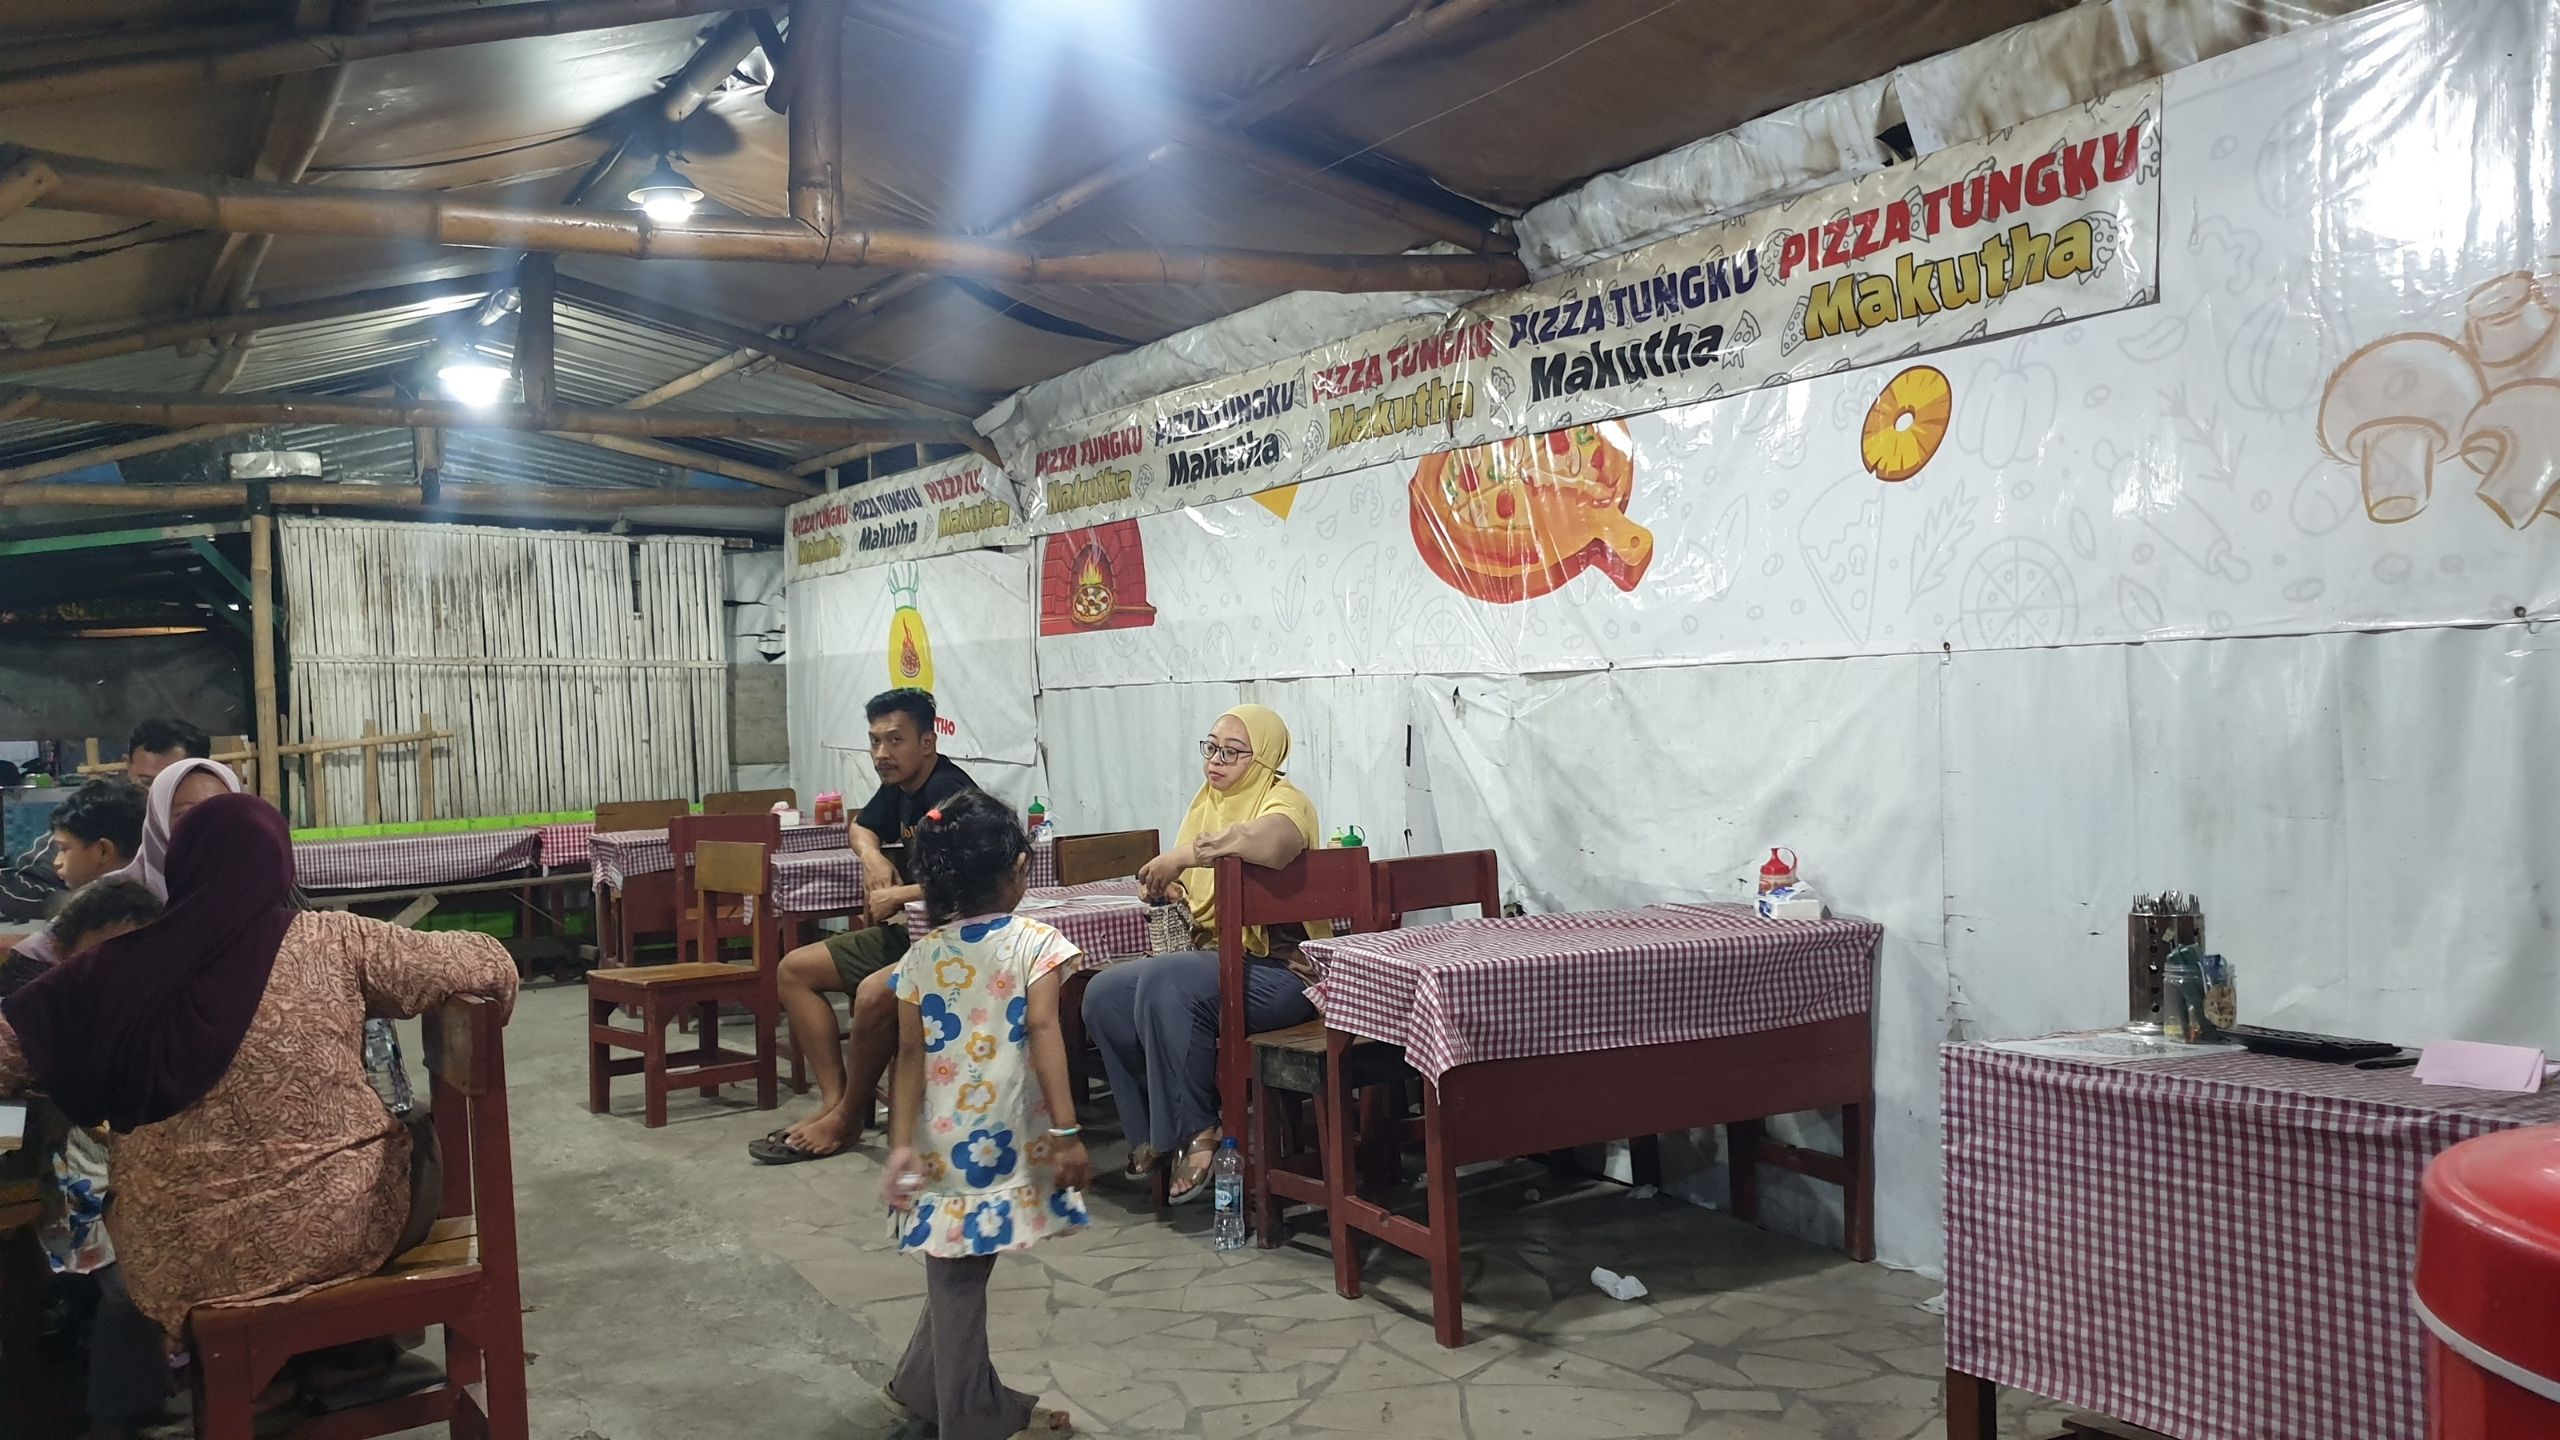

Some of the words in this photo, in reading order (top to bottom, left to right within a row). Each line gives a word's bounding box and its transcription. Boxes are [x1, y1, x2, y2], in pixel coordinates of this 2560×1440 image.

[1779, 200, 1912, 280] PIZZA
[1921, 125, 2142, 235] TUNGKU
[1508, 295, 1605, 350] PIZZA
[1609, 248, 1759, 328] TUNGKU
[1804, 218, 2094, 341] Makutha
[1312, 354, 1384, 405] PIZZA
[1388, 320, 1495, 382] TUNGKU
[1530, 323, 1724, 403] Makutha
[1154, 411, 1209, 447] PIZZA
[1211, 380, 1296, 429] TUNGKU
[1327, 377, 1474, 451] Makutha
[1035, 444, 1077, 478] PIZZA
[1079, 425, 1143, 467] TUNGKU
[1168, 431, 1280, 487] Makutha
[853, 497, 882, 521] PIZZA
[876, 486, 923, 515] TUNGKU
[923, 474, 963, 505] PIZZA
[1046, 466, 1132, 515] Makutha
[793, 513, 815, 538] PIZZA
[815, 505, 848, 531] TUNGKU
[859, 518, 917, 552] Makutha
[938, 499, 1010, 538] Makutha
[934, 716, 956, 736] THO
